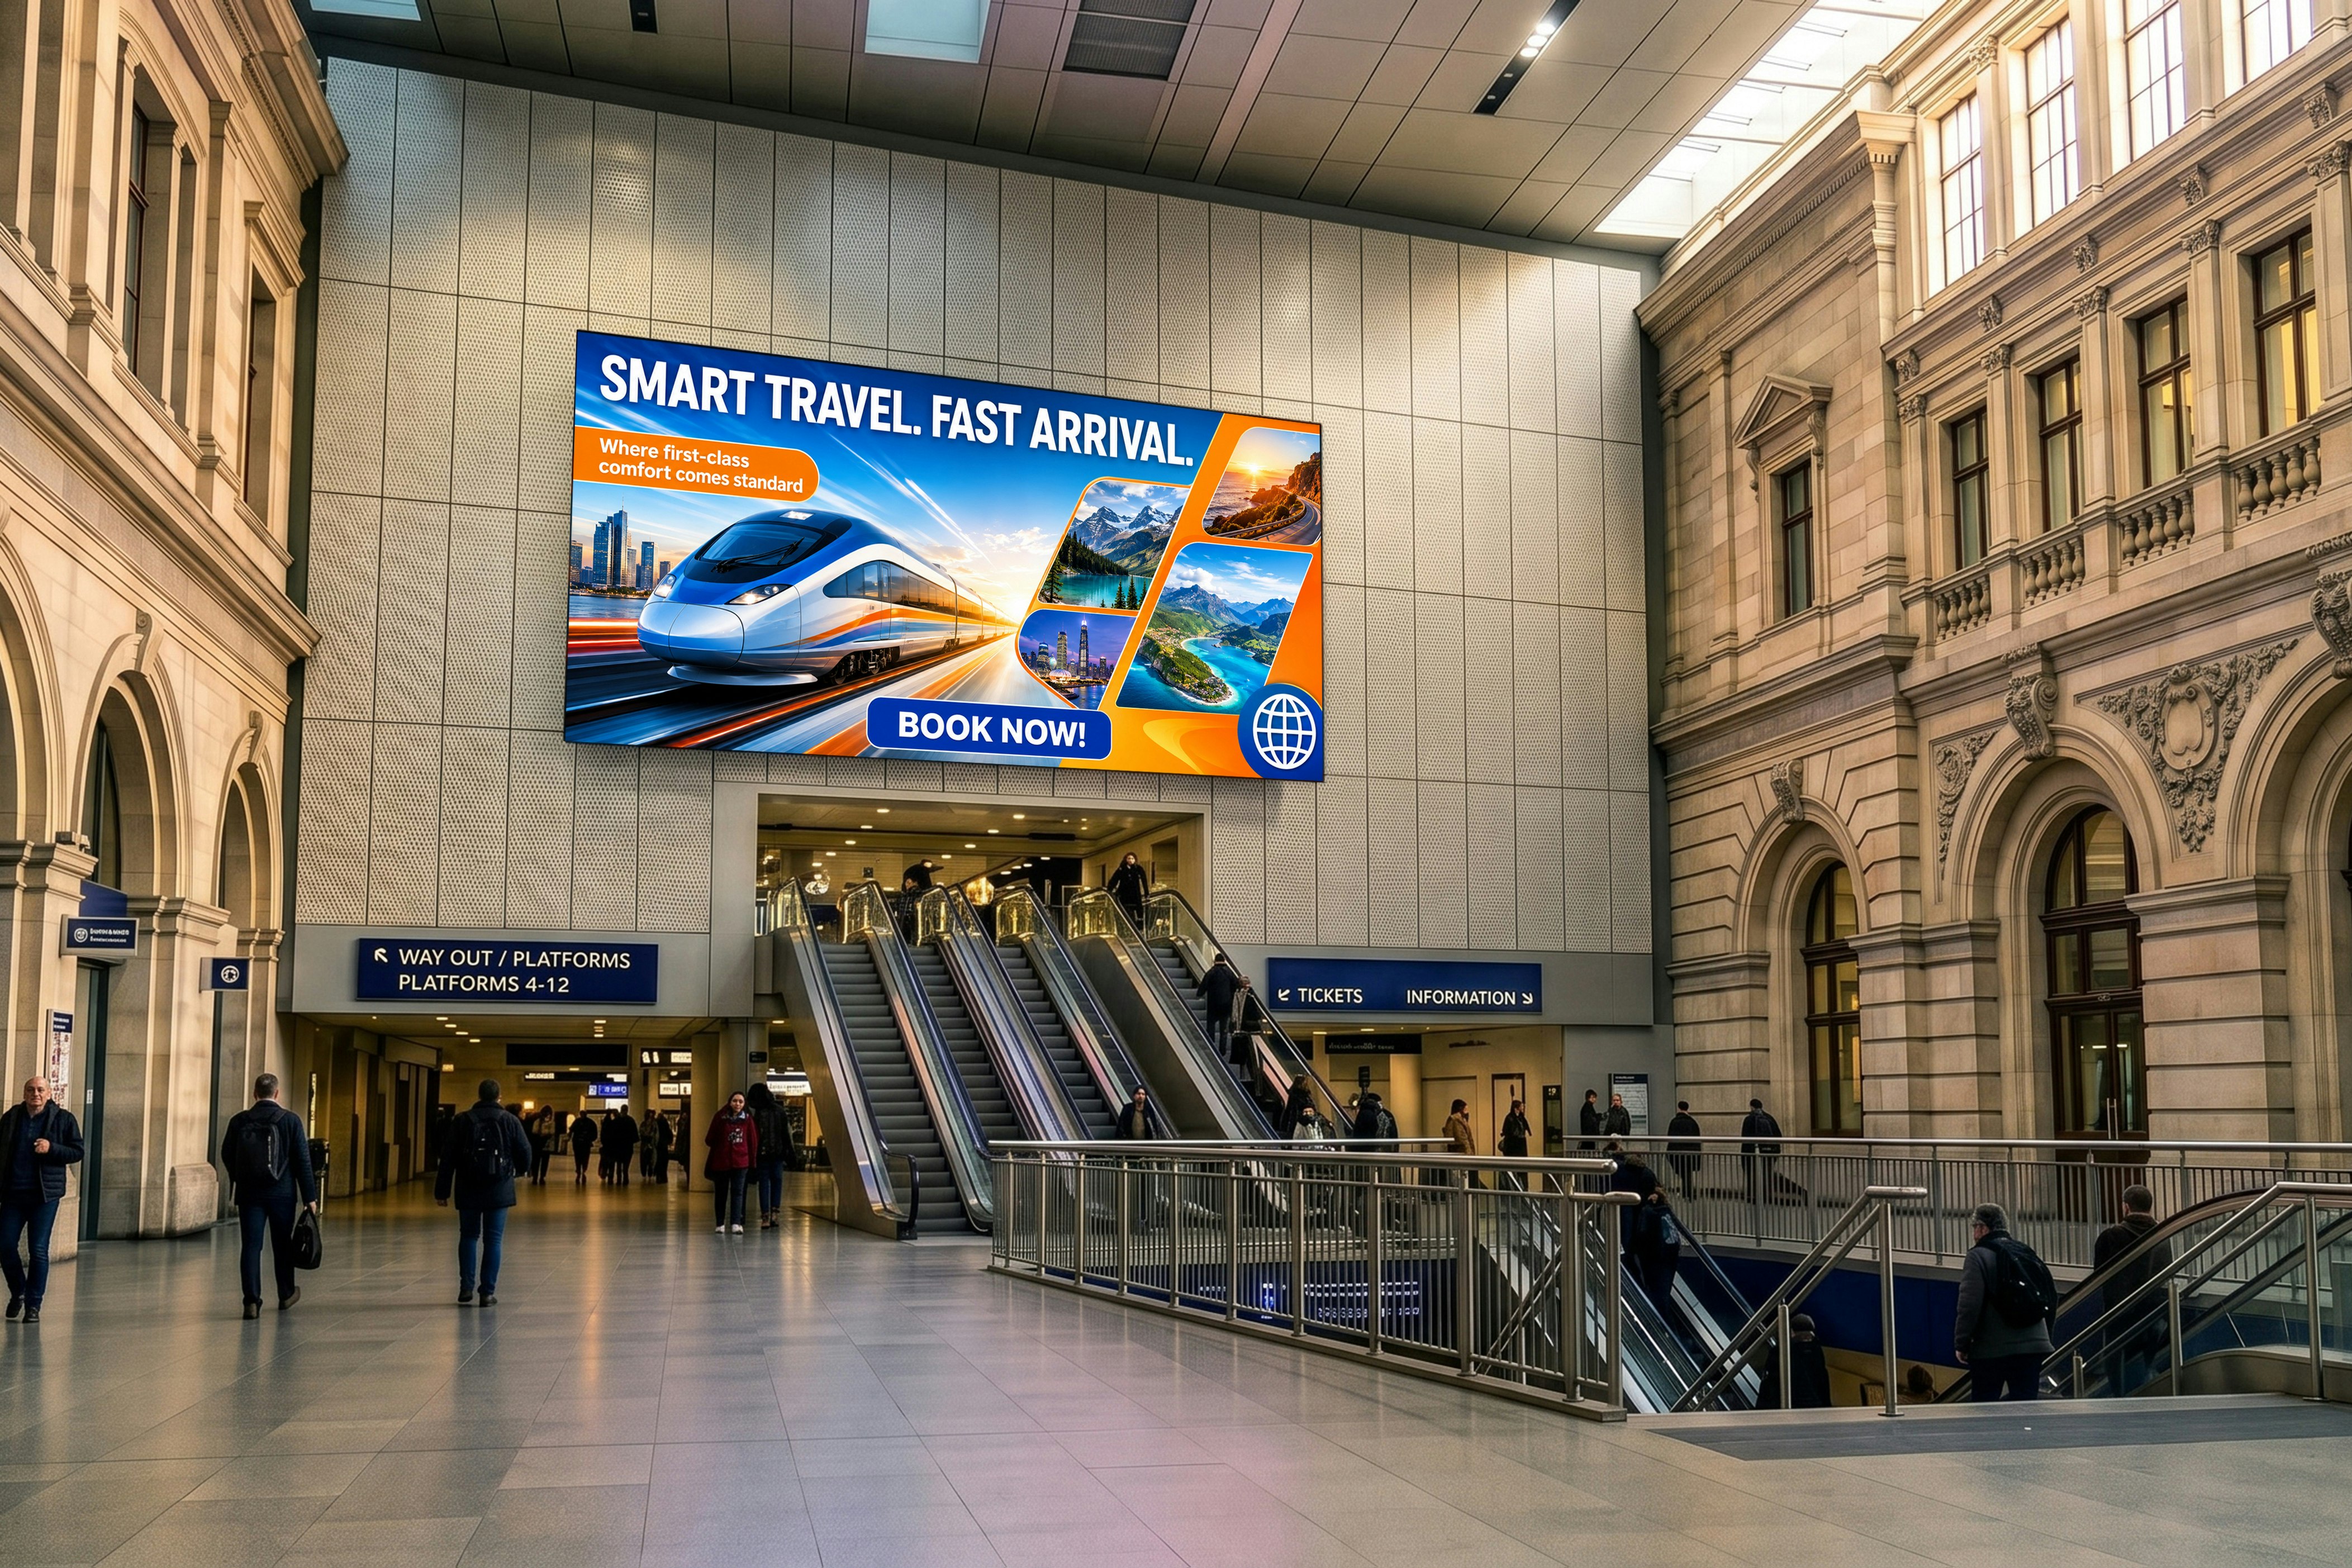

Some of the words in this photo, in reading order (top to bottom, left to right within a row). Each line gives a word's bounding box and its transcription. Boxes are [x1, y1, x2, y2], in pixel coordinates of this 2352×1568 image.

[600, 354, 755, 415] SMART
[764, 374, 921, 435] TRAVEL.
[932, 395, 1022, 445] FAST
[1029, 407, 1194, 467] ARRIVAL.
[599, 438, 659, 458] Where
[663, 444, 749, 468] first-class
[598, 461, 671, 481] comfort
[675, 469, 730, 486] comes
[733, 472, 803, 493] standard
[899, 711, 993, 742] BOOK
[1001, 718, 1086, 748] NOW!
[398, 948, 444, 966] WAY
[450, 949, 493, 966] OUT
[498, 950, 507, 967] /
[513, 951, 631, 969] PLATFORMS
[399, 974, 520, 992] PLATFORMS
[525, 977, 569, 993] 4-12
[1297, 987, 1363, 1004] TICKETS
[1407, 989, 1516, 1005] INFORMATION
